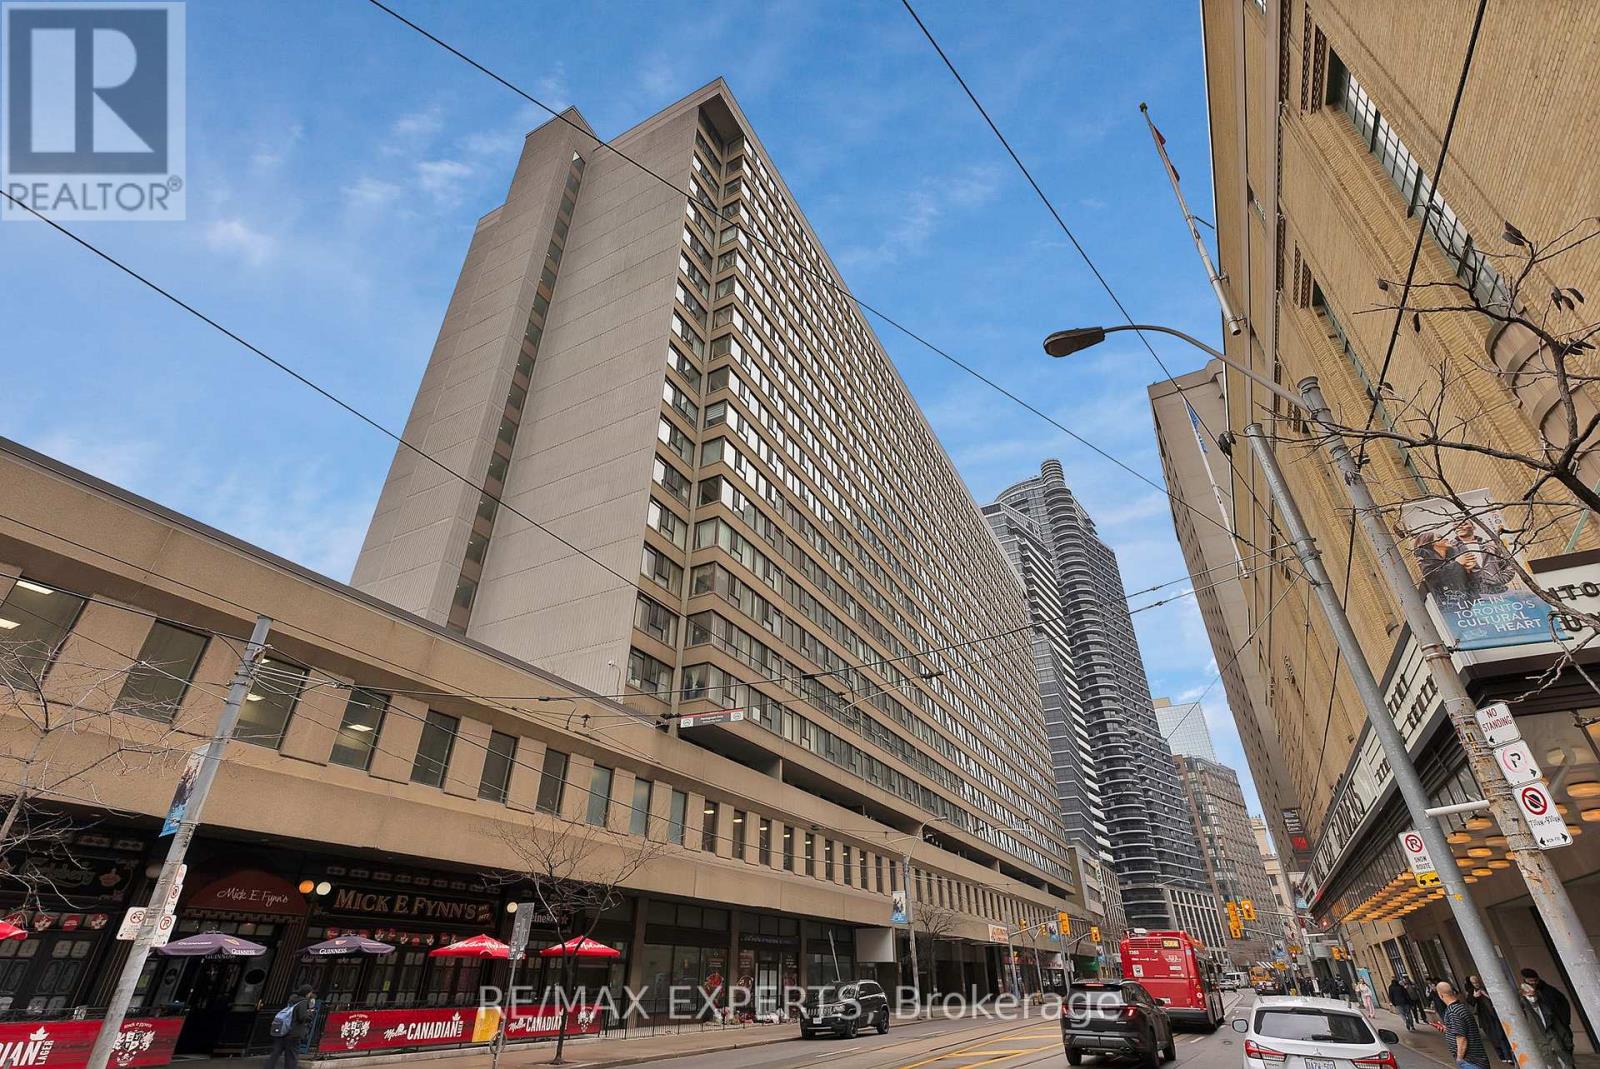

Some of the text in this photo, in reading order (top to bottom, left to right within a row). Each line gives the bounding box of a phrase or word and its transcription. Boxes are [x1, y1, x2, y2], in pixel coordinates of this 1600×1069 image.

[1454, 600, 1536, 619] TORONTO'S
[1457, 595, 1505, 610] LIVE IN
[1457, 611, 1529, 628] CULTURAL
[1494, 618, 1541, 633] HEART
[1485, 707, 1498, 719] NO
[1482, 715, 1513, 732] STANDING
[216, 887, 248, 901] Mick
[333, 888, 479, 920] MICK E FYNN'S
[407, 1020, 459, 1040] CANADIAN
[35, 1040, 54, 1066] LAGER
